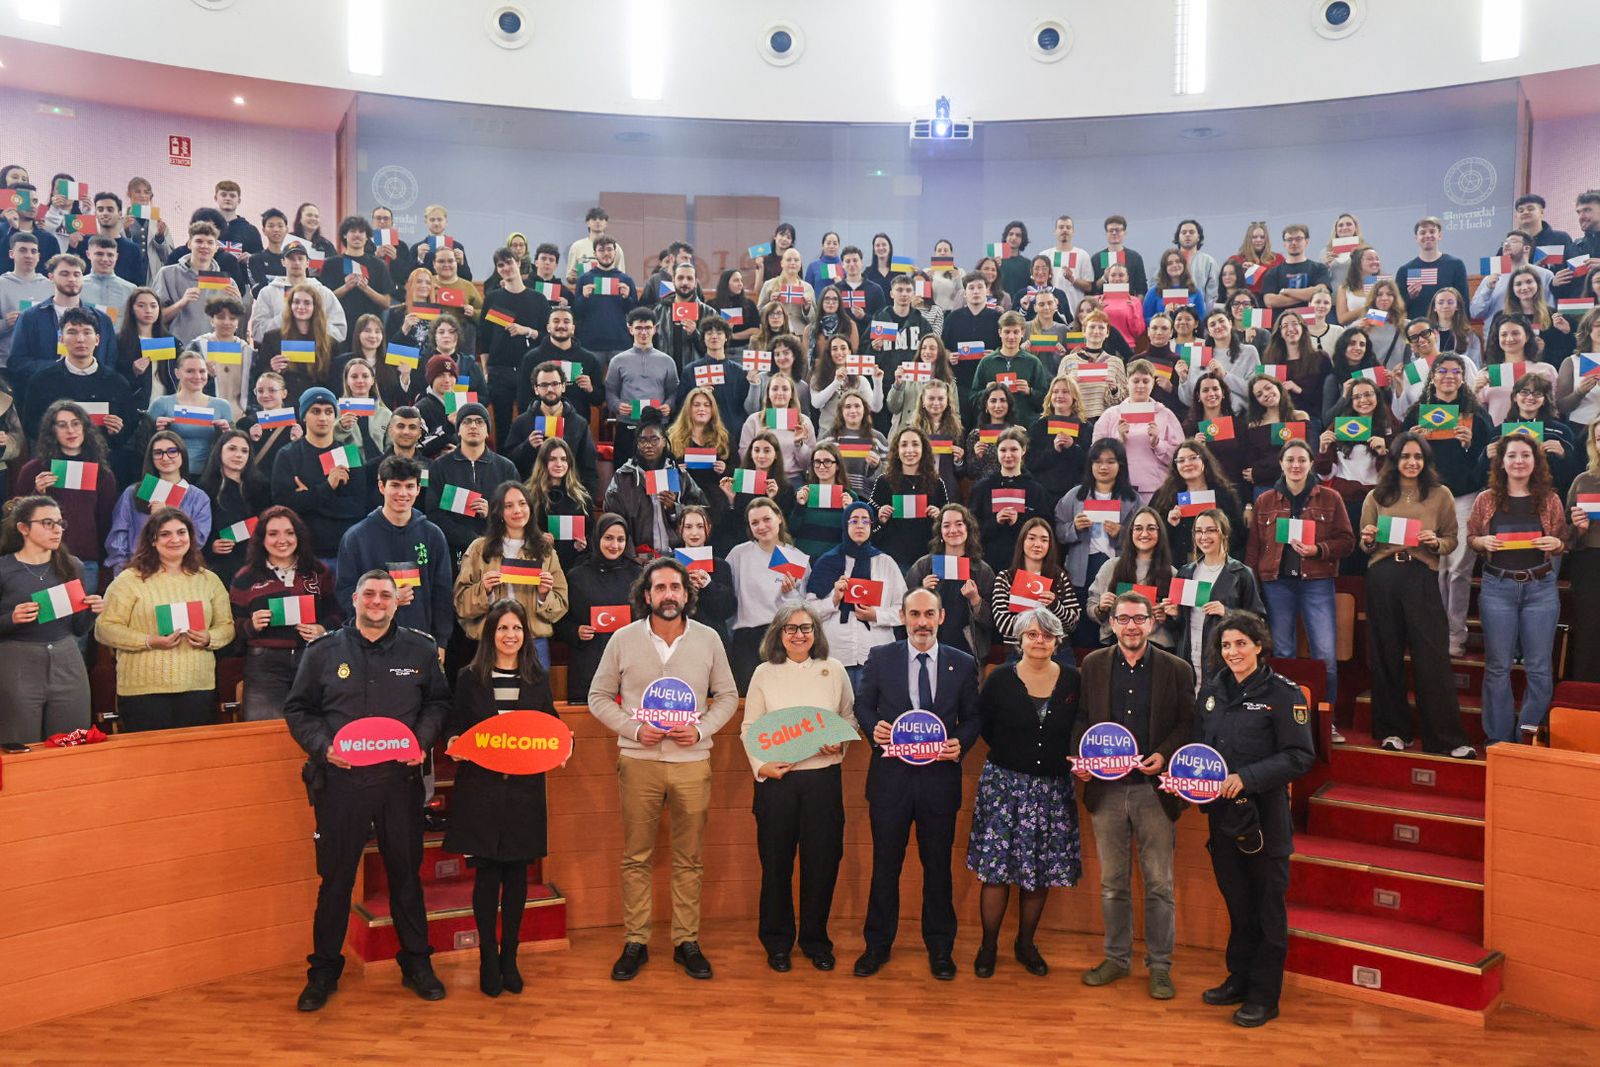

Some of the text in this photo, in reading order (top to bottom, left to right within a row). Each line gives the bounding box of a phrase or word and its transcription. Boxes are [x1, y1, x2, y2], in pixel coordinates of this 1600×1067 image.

[1460, 218, 1491, 229] Huelva
[650, 687, 693, 703] HUELVA
[636, 709, 697, 723] ERASMUS
[757, 718, 815, 751] Salut
[897, 722, 941, 734] HUELVA
[340, 737, 410, 752] Welcome
[475, 733, 559, 750] Welcome
[1086, 734, 1131, 747] HUELVA
[1076, 755, 1139, 770] ERASMUS
[1164, 777, 1221, 793] ERASMU
